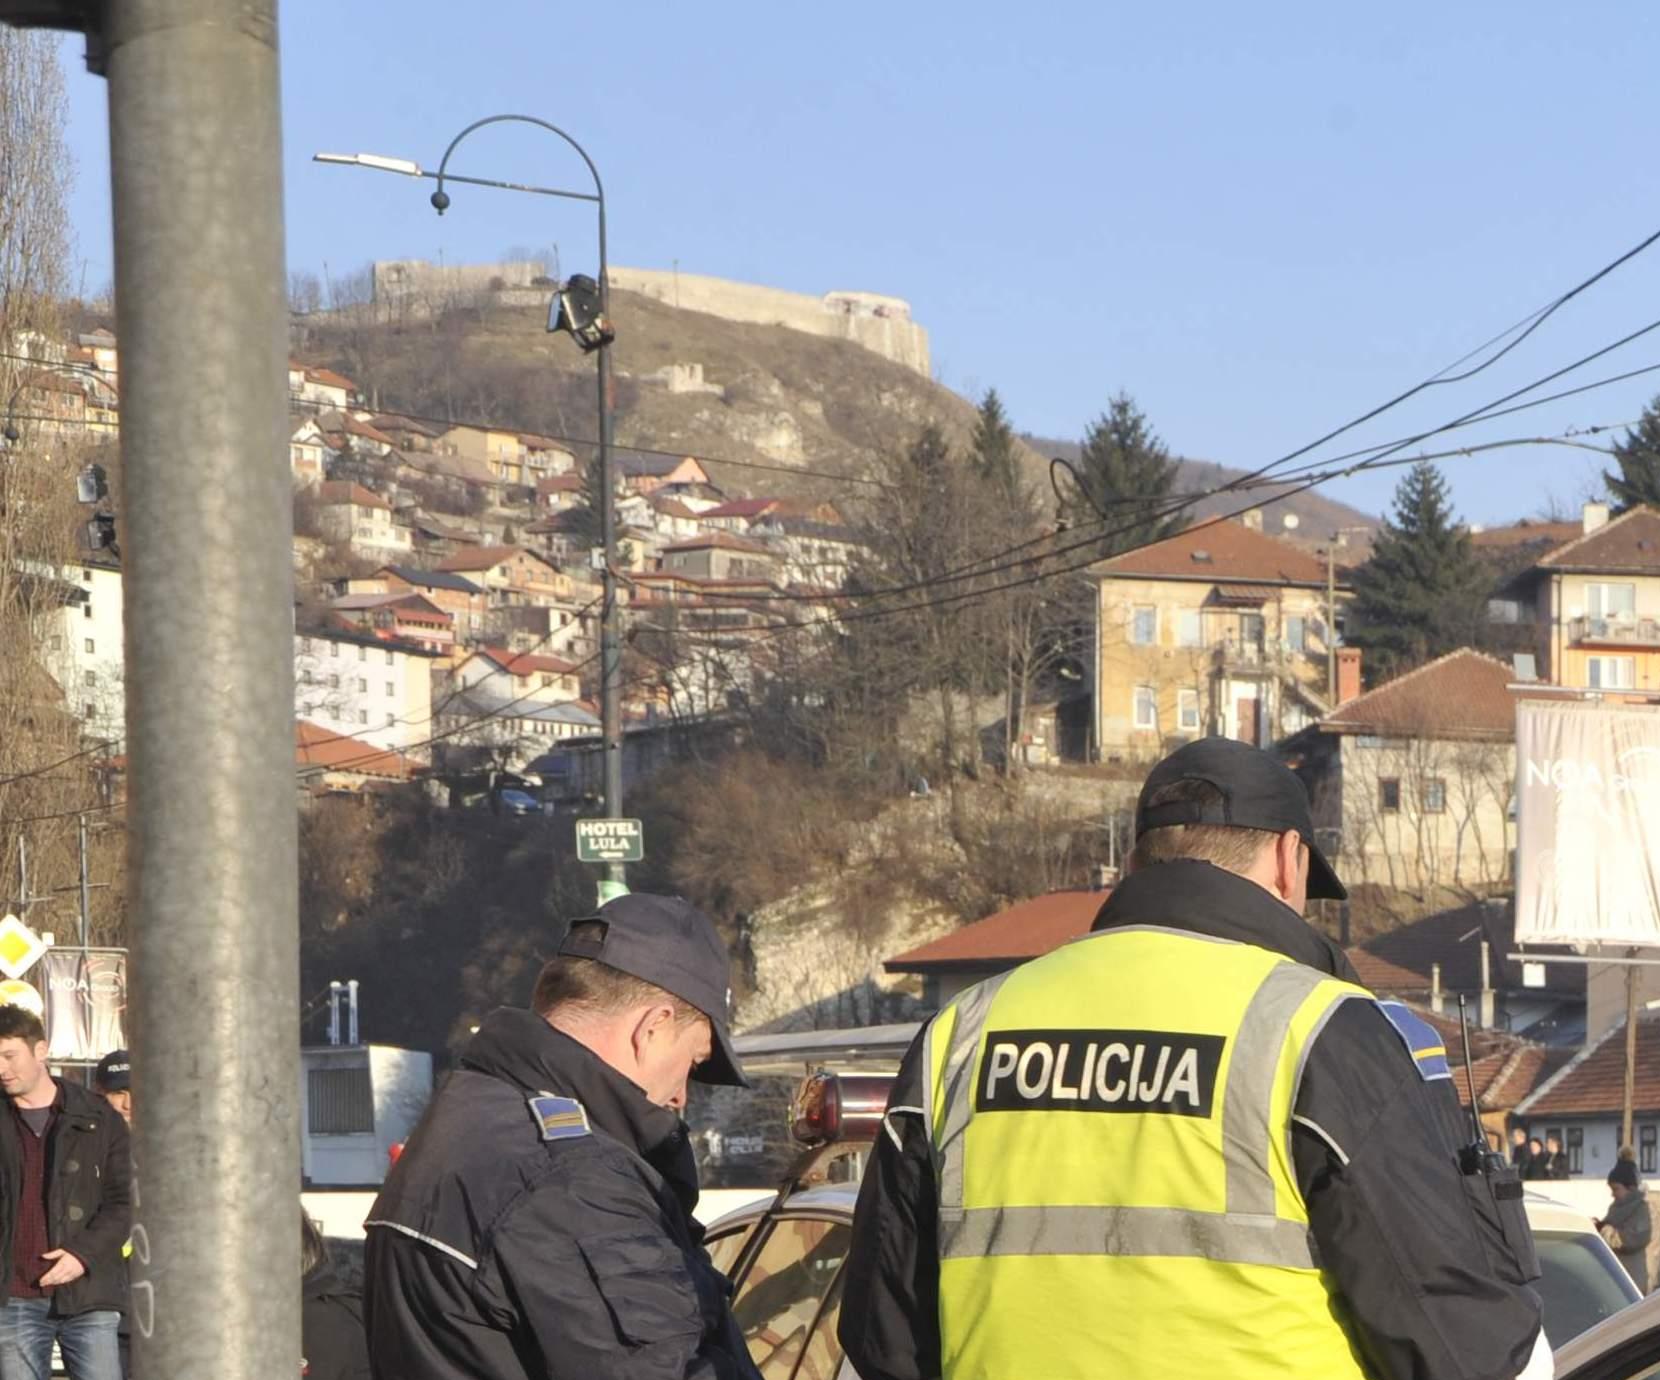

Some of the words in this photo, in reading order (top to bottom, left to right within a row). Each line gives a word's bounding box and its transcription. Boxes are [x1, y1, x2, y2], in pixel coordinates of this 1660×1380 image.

[580, 822, 639, 837] HOTEL
[589, 837, 631, 850] LULA
[985, 1041, 1200, 1107] POLICIJA
